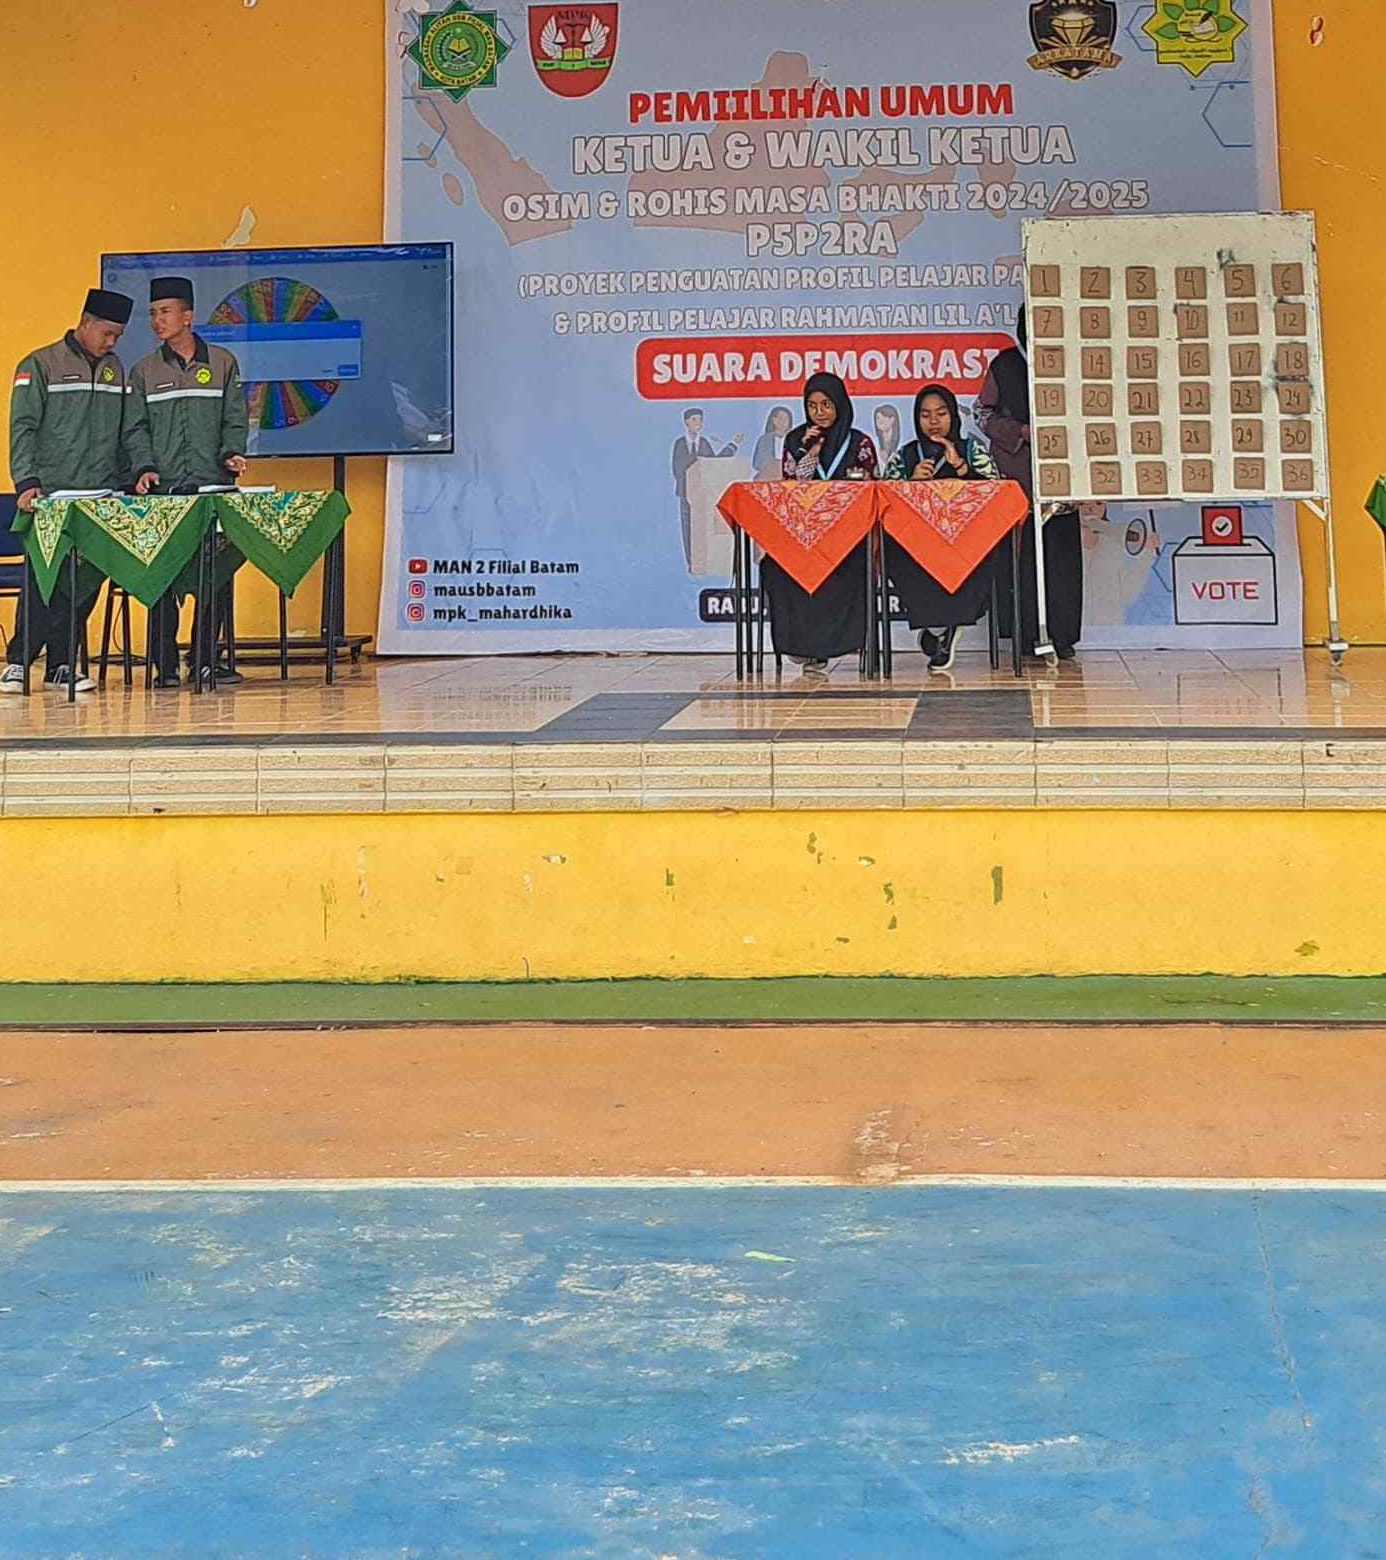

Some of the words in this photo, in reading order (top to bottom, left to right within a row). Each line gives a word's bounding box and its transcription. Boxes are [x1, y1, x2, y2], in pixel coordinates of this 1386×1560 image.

[629, 86, 870, 123] PEMIILIHAN
[881, 84, 1013, 116] UMUM
[573, 133, 714, 174] KETUA
[724, 132, 755, 170] &
[766, 127, 920, 169] WAKIL
[929, 125, 1076, 167] KETUA
[502, 192, 591, 222] OSIM
[598, 191, 619, 219] &
[627, 187, 728, 218] ROHIS
[735, 185, 830, 215] MASA
[838, 183, 959, 213] BHAKTI
[966, 179, 1150, 212] 2024/2025
[745, 221, 899, 257] P5P2RA
[518, 271, 624, 298] (PROYEK
[629, 268, 780, 294] PENGUATAN
[784, 265, 874, 290] PROFIL
[878, 263, 988, 288] PELAJAR
[1041, 269, 1048, 292] 1
[1089, 271, 1100, 293] 2
[1135, 271, 1147, 293] 3
[1184, 270, 1196, 296] 4
[1232, 269, 1244, 291] 5
[1281, 267, 1293, 290] 6
[553, 311, 570, 334] &
[576, 309, 663, 333] PROFIL
[668, 307, 774, 331] PELAJAR
[780, 304, 927, 329] RAHMATAN
[933, 303, 970, 327] LIL
[1043, 310, 1051, 333] 7
[1091, 313, 1099, 329] 8
[1185, 310, 1199, 330] 10
[1283, 313, 1298, 326] 12
[653, 351, 772, 383] SUARA
[1041, 353, 1055, 368] 13
[1090, 354, 1104, 373] 14
[1134, 353, 1153, 369] 15
[1187, 351, 1202, 368] 16
[1237, 351, 1254, 370] 17
[1285, 350, 1303, 369] 18
[1042, 390, 1060, 408] 19
[1085, 391, 1109, 408] 20
[1133, 391, 1152, 410] 21
[1185, 389, 1205, 407] 22
[1235, 389, 1252, 407] 23
[1285, 389, 1301, 406] 24
[1044, 435, 1061, 451] 25
[1092, 431, 1111, 446] 26
[1137, 431, 1154, 449] 27
[1236, 427, 1253, 445] 29
[1284, 429, 1306, 447] 30
[1046, 470, 1061, 485] 31
[1142, 469, 1163, 485] 33
[1188, 466, 1206, 481] 34
[1287, 464, 1308, 482] 36
[433, 560, 472, 574] MAN
[476, 560, 485, 574] 2
[488, 560, 526, 574] Filial
[530, 560, 579, 574] Batam
[434, 583, 536, 597] mausbbatam
[1192, 582, 1259, 600] VOTE
[433, 605, 573, 623] mpk_mahardhika
